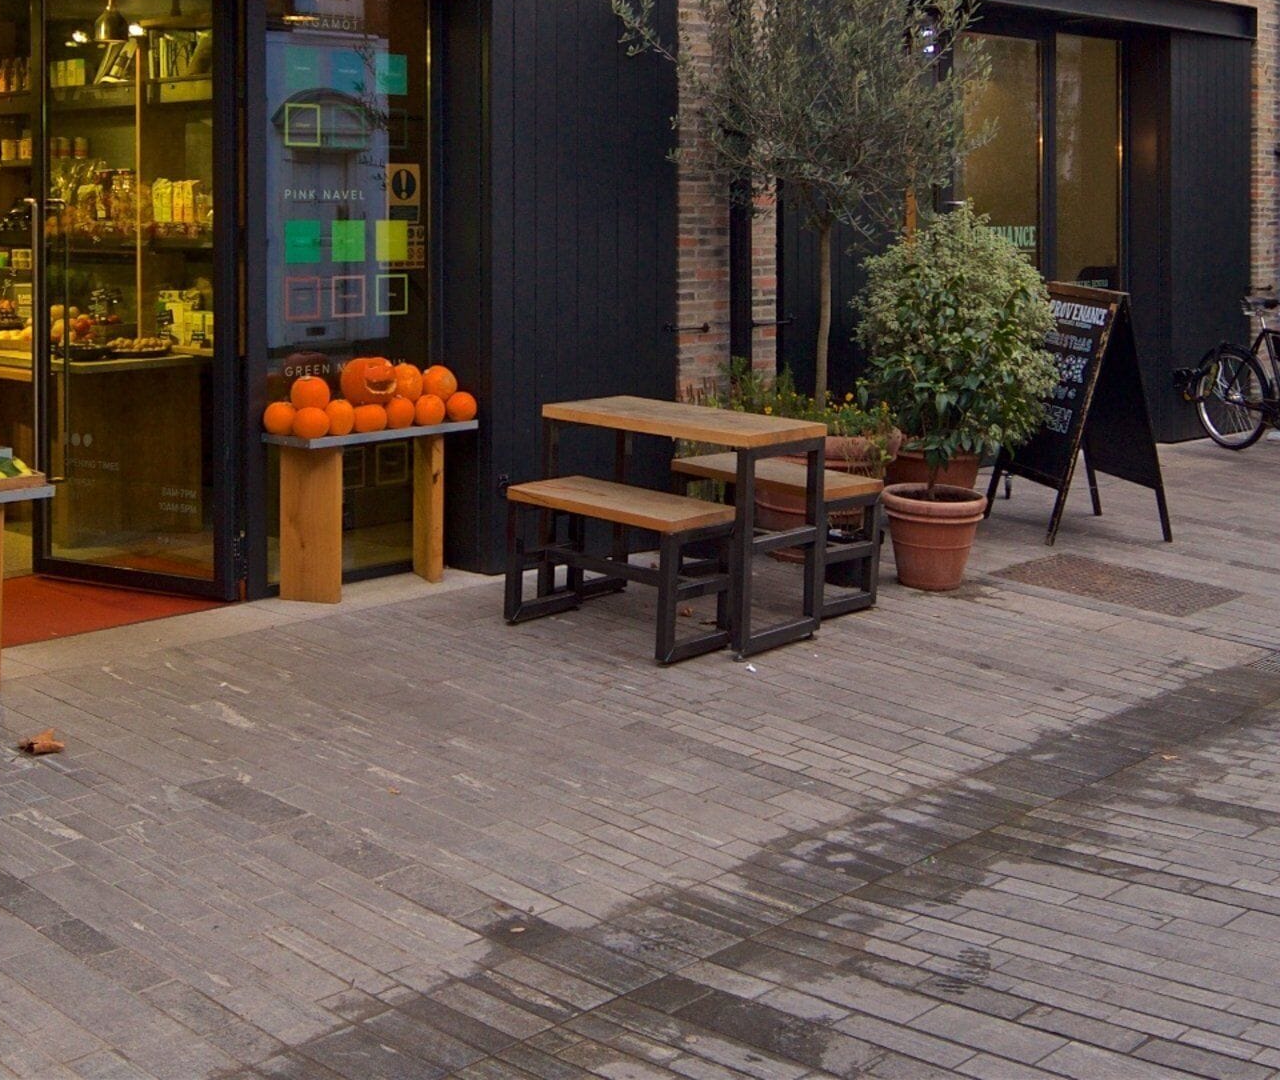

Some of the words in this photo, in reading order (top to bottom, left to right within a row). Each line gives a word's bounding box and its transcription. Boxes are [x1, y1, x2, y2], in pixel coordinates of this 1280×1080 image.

[284, 189, 316, 200] PINK
[323, 189, 365, 200] NAVEL
[1049, 299, 1108, 326] PROVENANCE
[284, 364, 330, 377] GREEN
